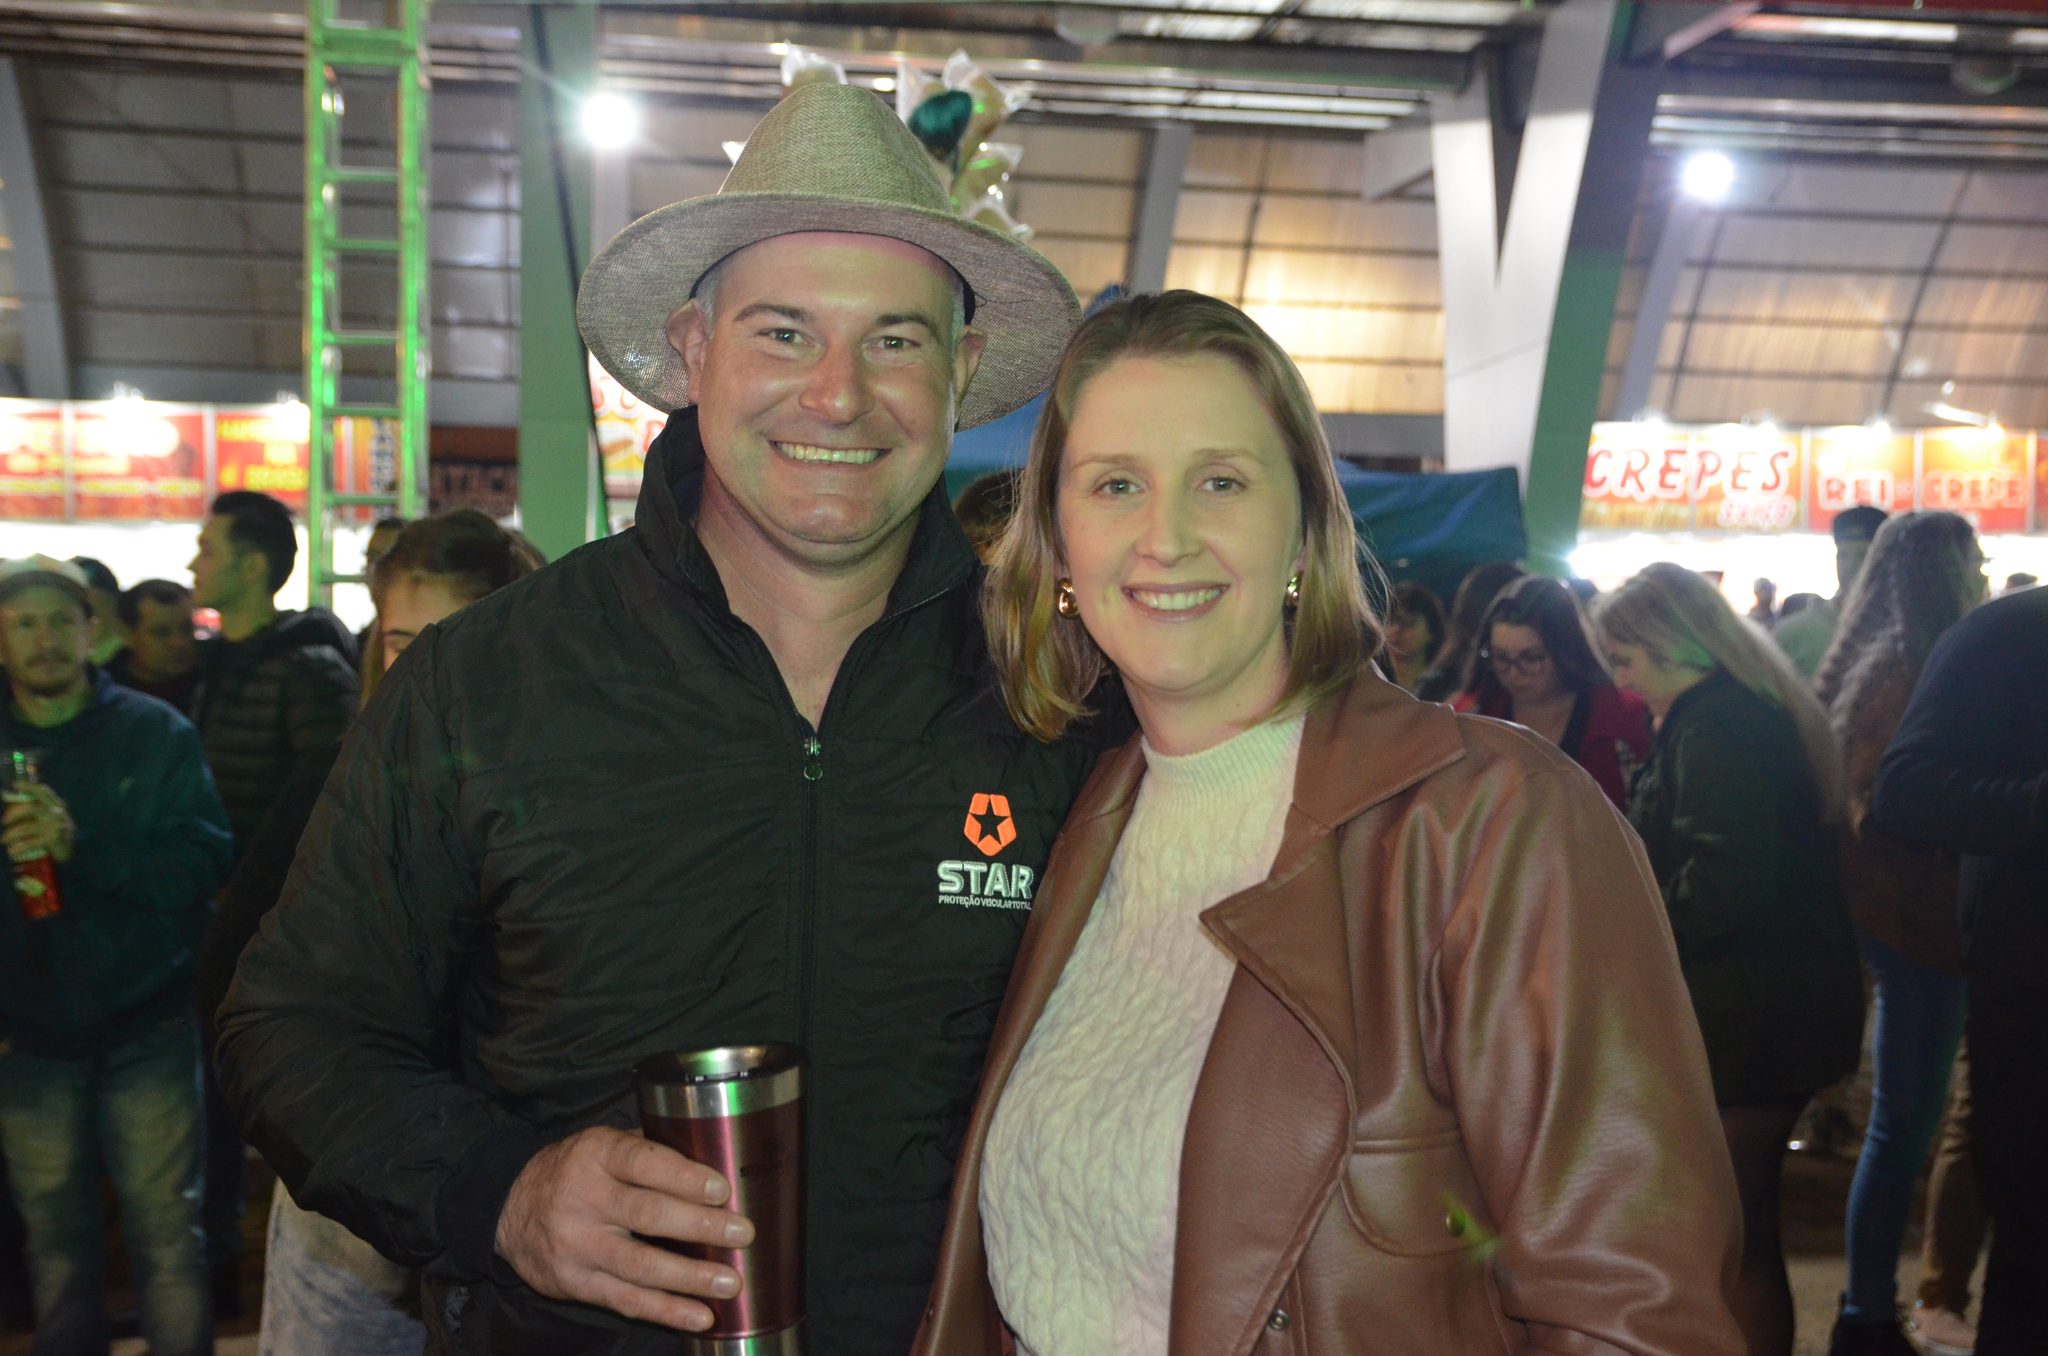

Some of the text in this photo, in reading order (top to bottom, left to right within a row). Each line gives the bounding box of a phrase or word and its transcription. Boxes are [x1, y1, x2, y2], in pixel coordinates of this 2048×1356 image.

[1584, 447, 1790, 494] CREPES
[1824, 476, 1888, 505] REI
[937, 859, 1034, 899] STAR
[938, 895, 981, 909] PROTEÇÃO
[1011, 901, 1032, 911] TOTAL
